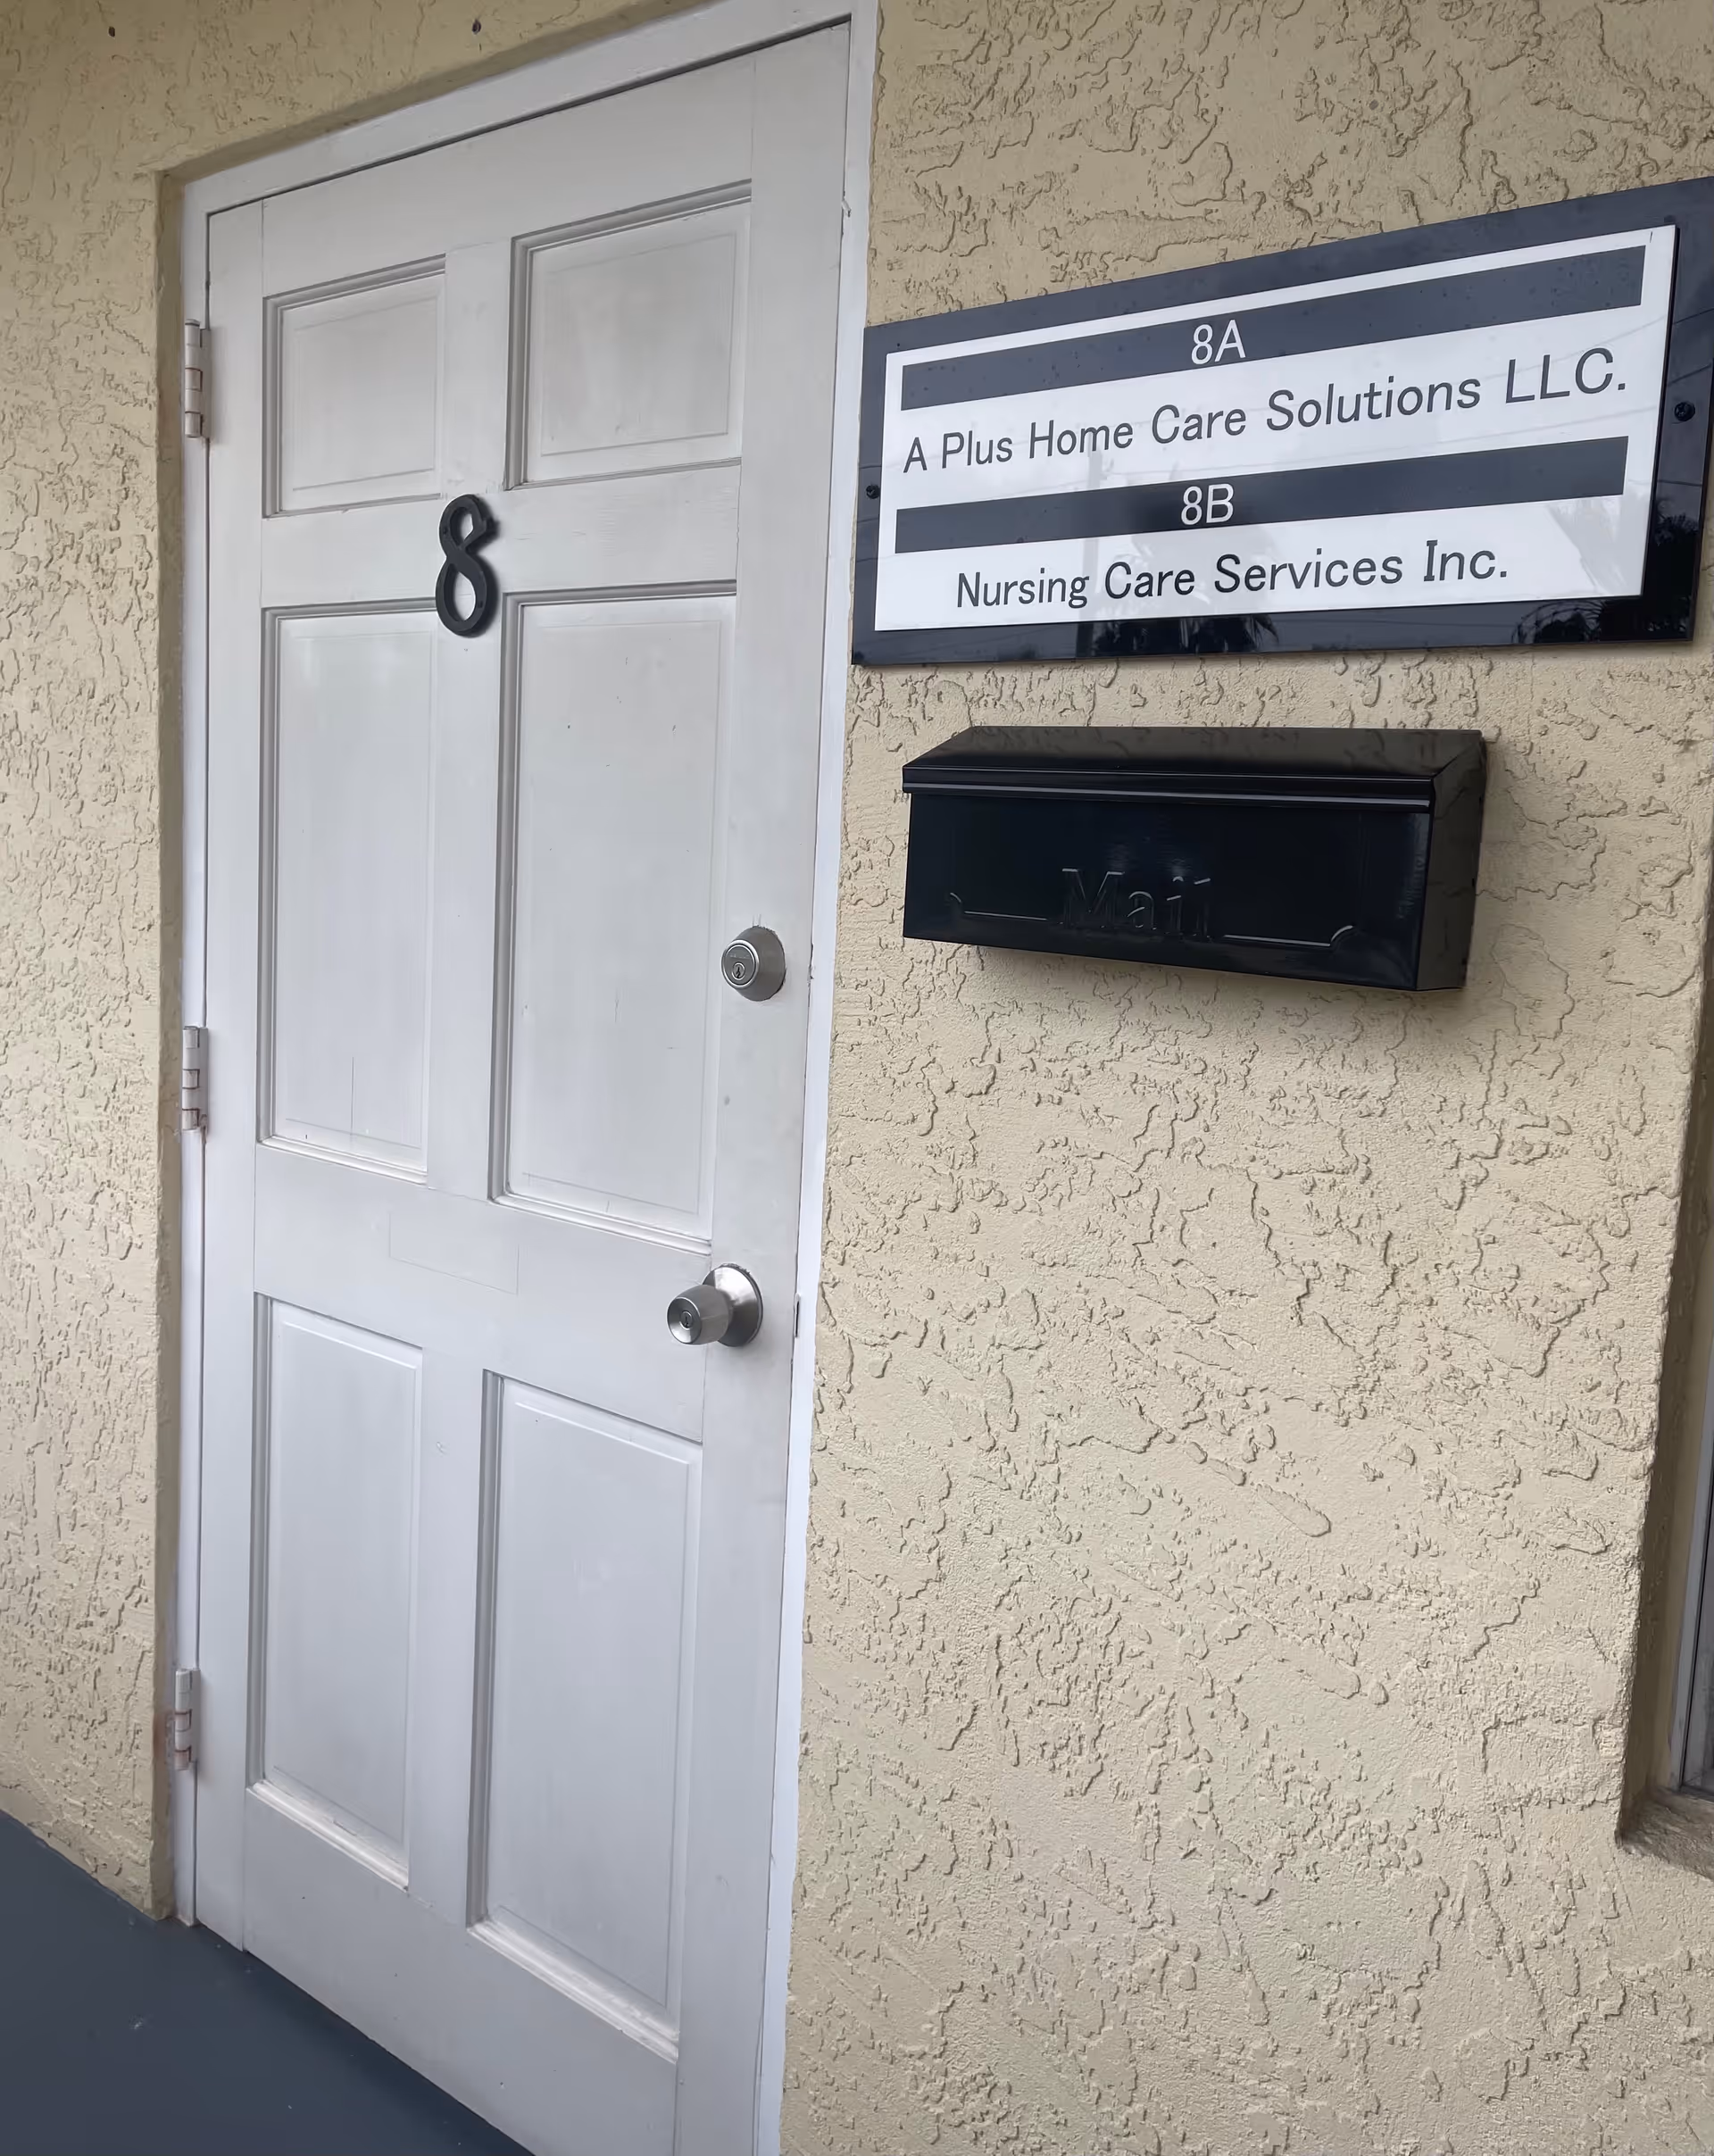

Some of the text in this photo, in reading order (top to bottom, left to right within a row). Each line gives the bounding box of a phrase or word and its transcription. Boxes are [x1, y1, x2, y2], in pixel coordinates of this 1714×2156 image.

[1191, 319, 1246, 365] 8A
[903, 347, 1626, 474] A Plus Home Care Solutions LLC.
[1181, 483, 1234, 526] 8B
[435, 493, 493, 637] 8
[957, 539, 1508, 610] Nursing Care Services Inc.
[1061, 866, 1211, 941] Mail
